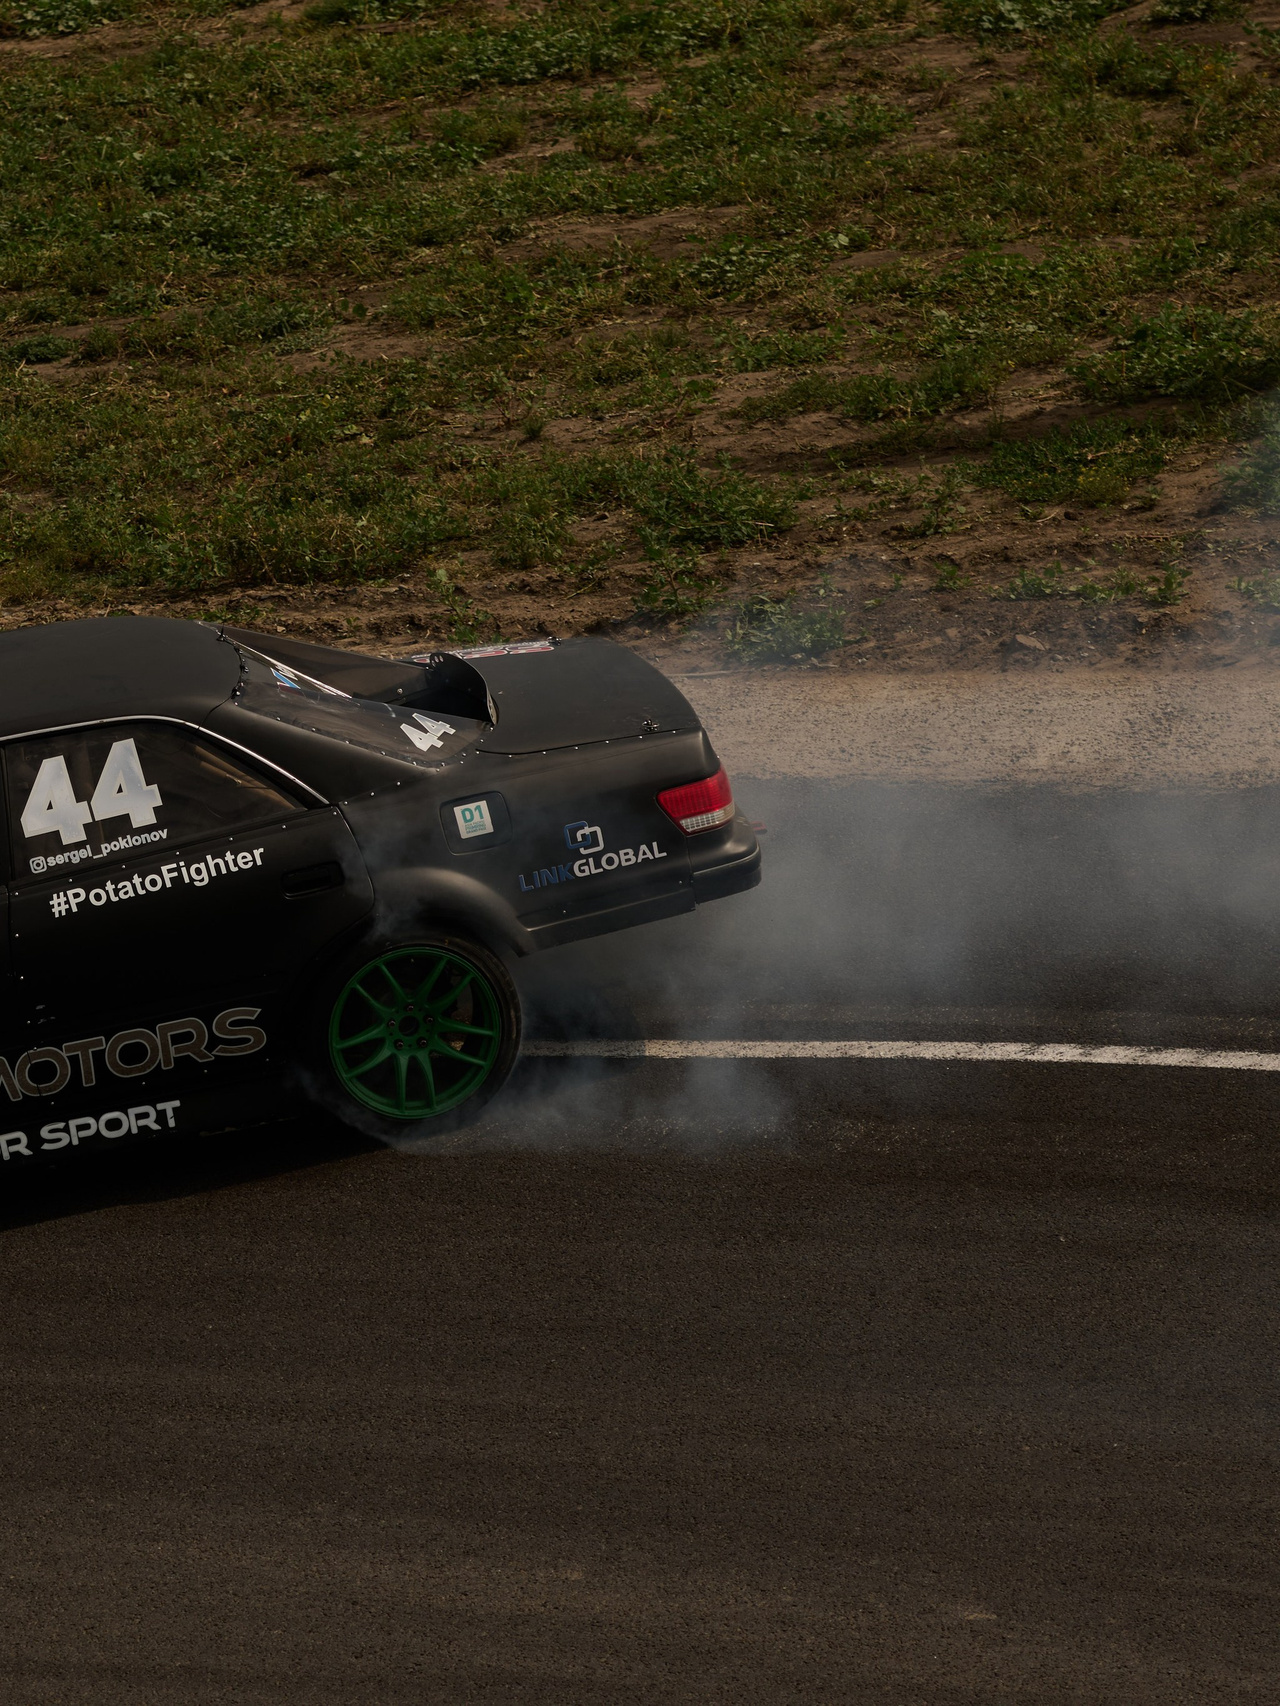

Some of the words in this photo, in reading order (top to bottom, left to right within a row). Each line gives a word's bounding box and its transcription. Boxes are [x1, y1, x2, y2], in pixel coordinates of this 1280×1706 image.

[399, 712, 456, 752] 44
[20, 738, 163, 846] 44
[461, 805, 484, 823] D1
[46, 828, 169, 867] sergei_poklonov
[49, 847, 265, 919] #PotatoFighter
[40, 1100, 181, 1152] SPORT
